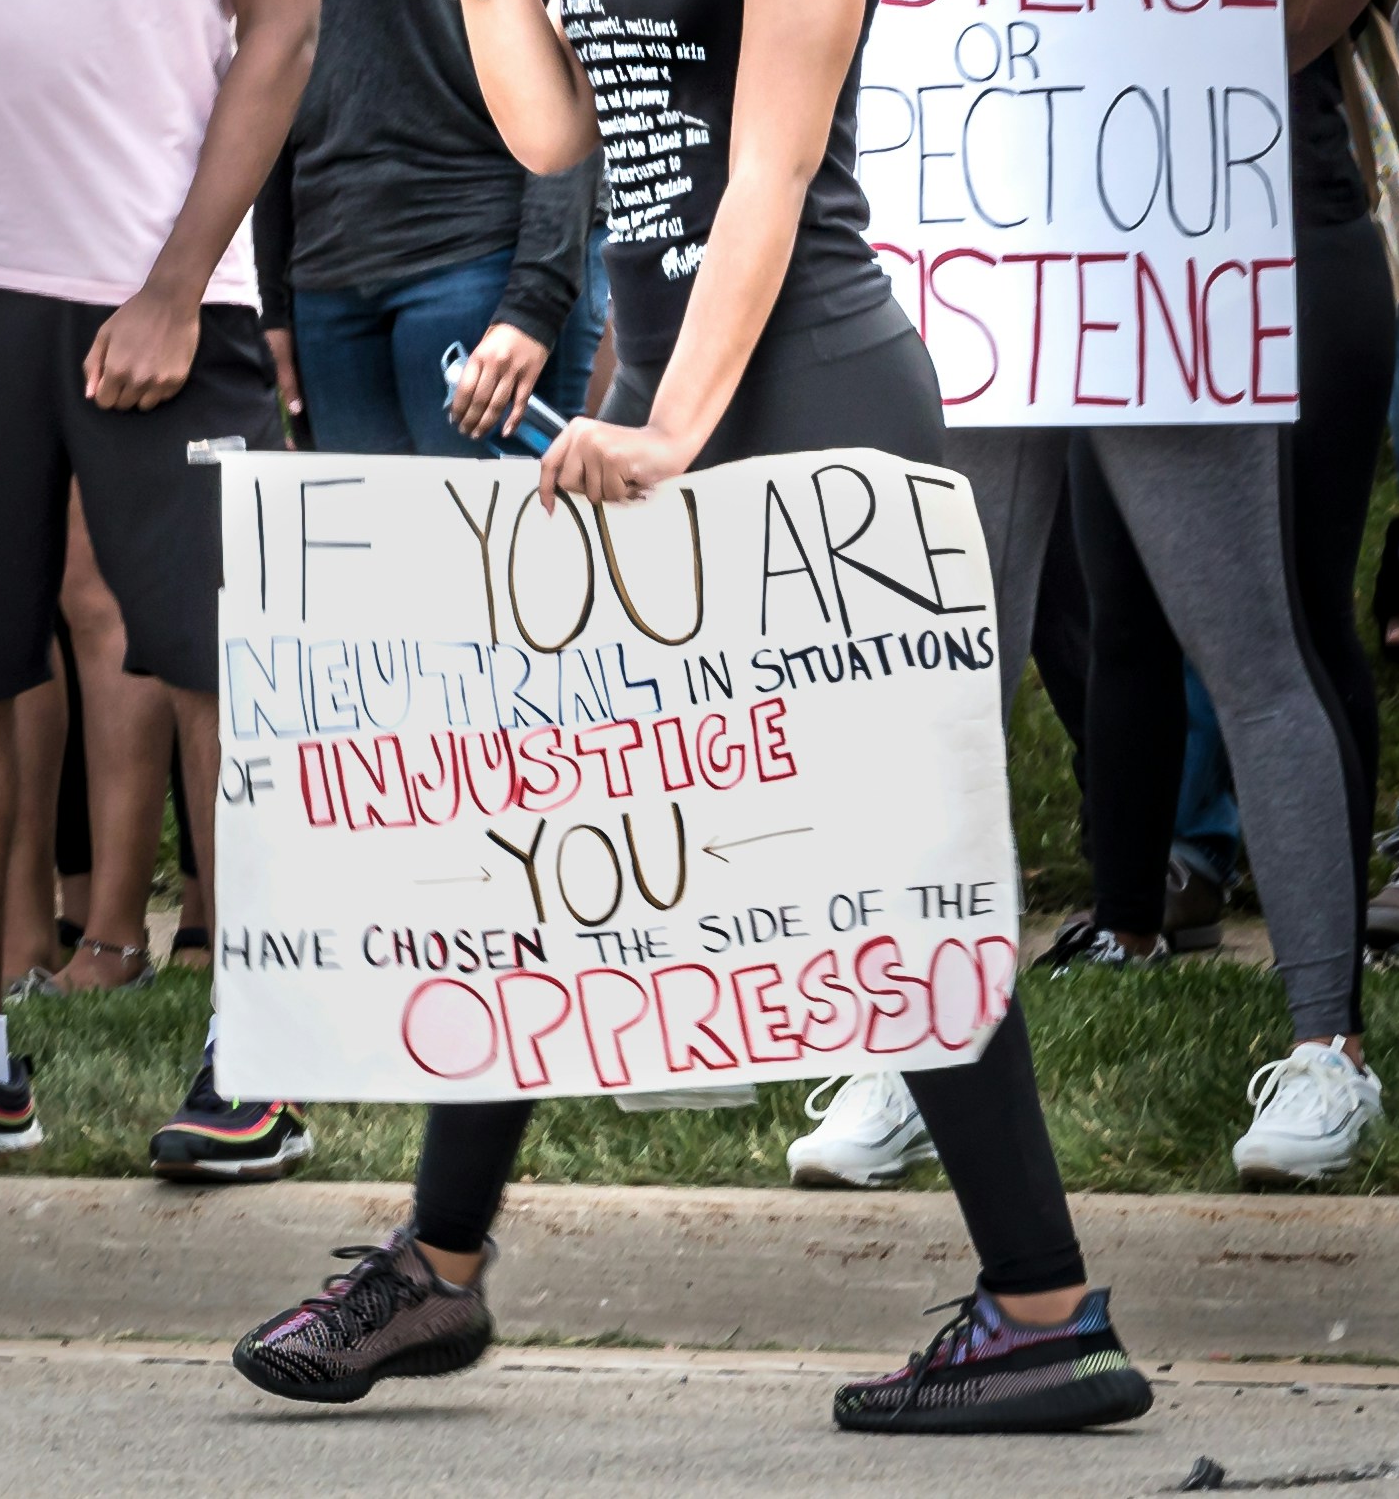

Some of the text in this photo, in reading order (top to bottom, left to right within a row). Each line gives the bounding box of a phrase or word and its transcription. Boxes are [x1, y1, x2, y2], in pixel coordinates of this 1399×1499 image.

[955, 20, 1041, 82] OR
[859, 83, 1086, 228] PECT
[1096, 83, 1282, 237] OUR
[871, 242, 1298, 406] ISTENCE
[253, 464, 987, 652] IF YOU ARE
[224, 627, 996, 741] NEUTRAL IN SITUATIONS
[220, 696, 798, 832] OF INJUSTICE
[221, 880, 997, 975] HAVE CHOSEN THE SIDE OF THE
[485, 802, 687, 929] YOU
